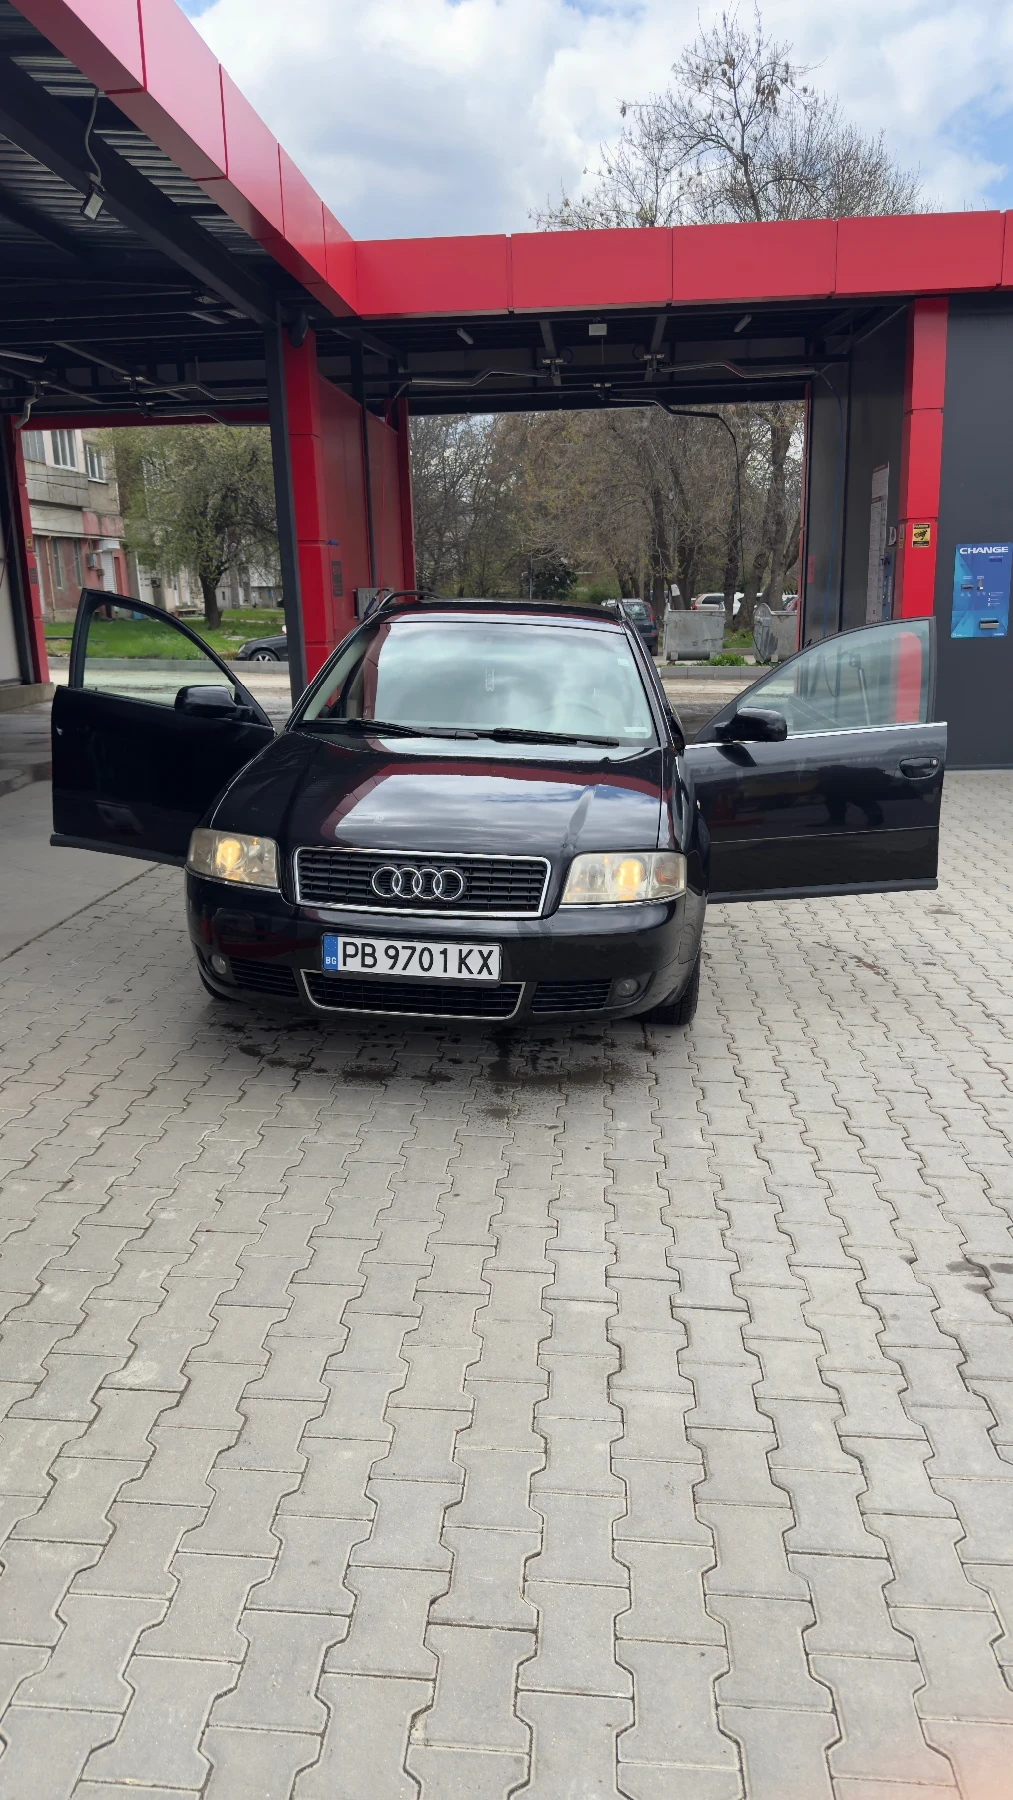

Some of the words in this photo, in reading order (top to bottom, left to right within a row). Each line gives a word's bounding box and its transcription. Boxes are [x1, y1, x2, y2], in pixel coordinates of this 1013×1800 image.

[960, 546, 1008, 554] CHANGE
[325, 956, 337, 965] BG
[342, 941, 378, 968] PB
[384, 944, 448, 973] 9701
[457, 948, 494, 976] KX
